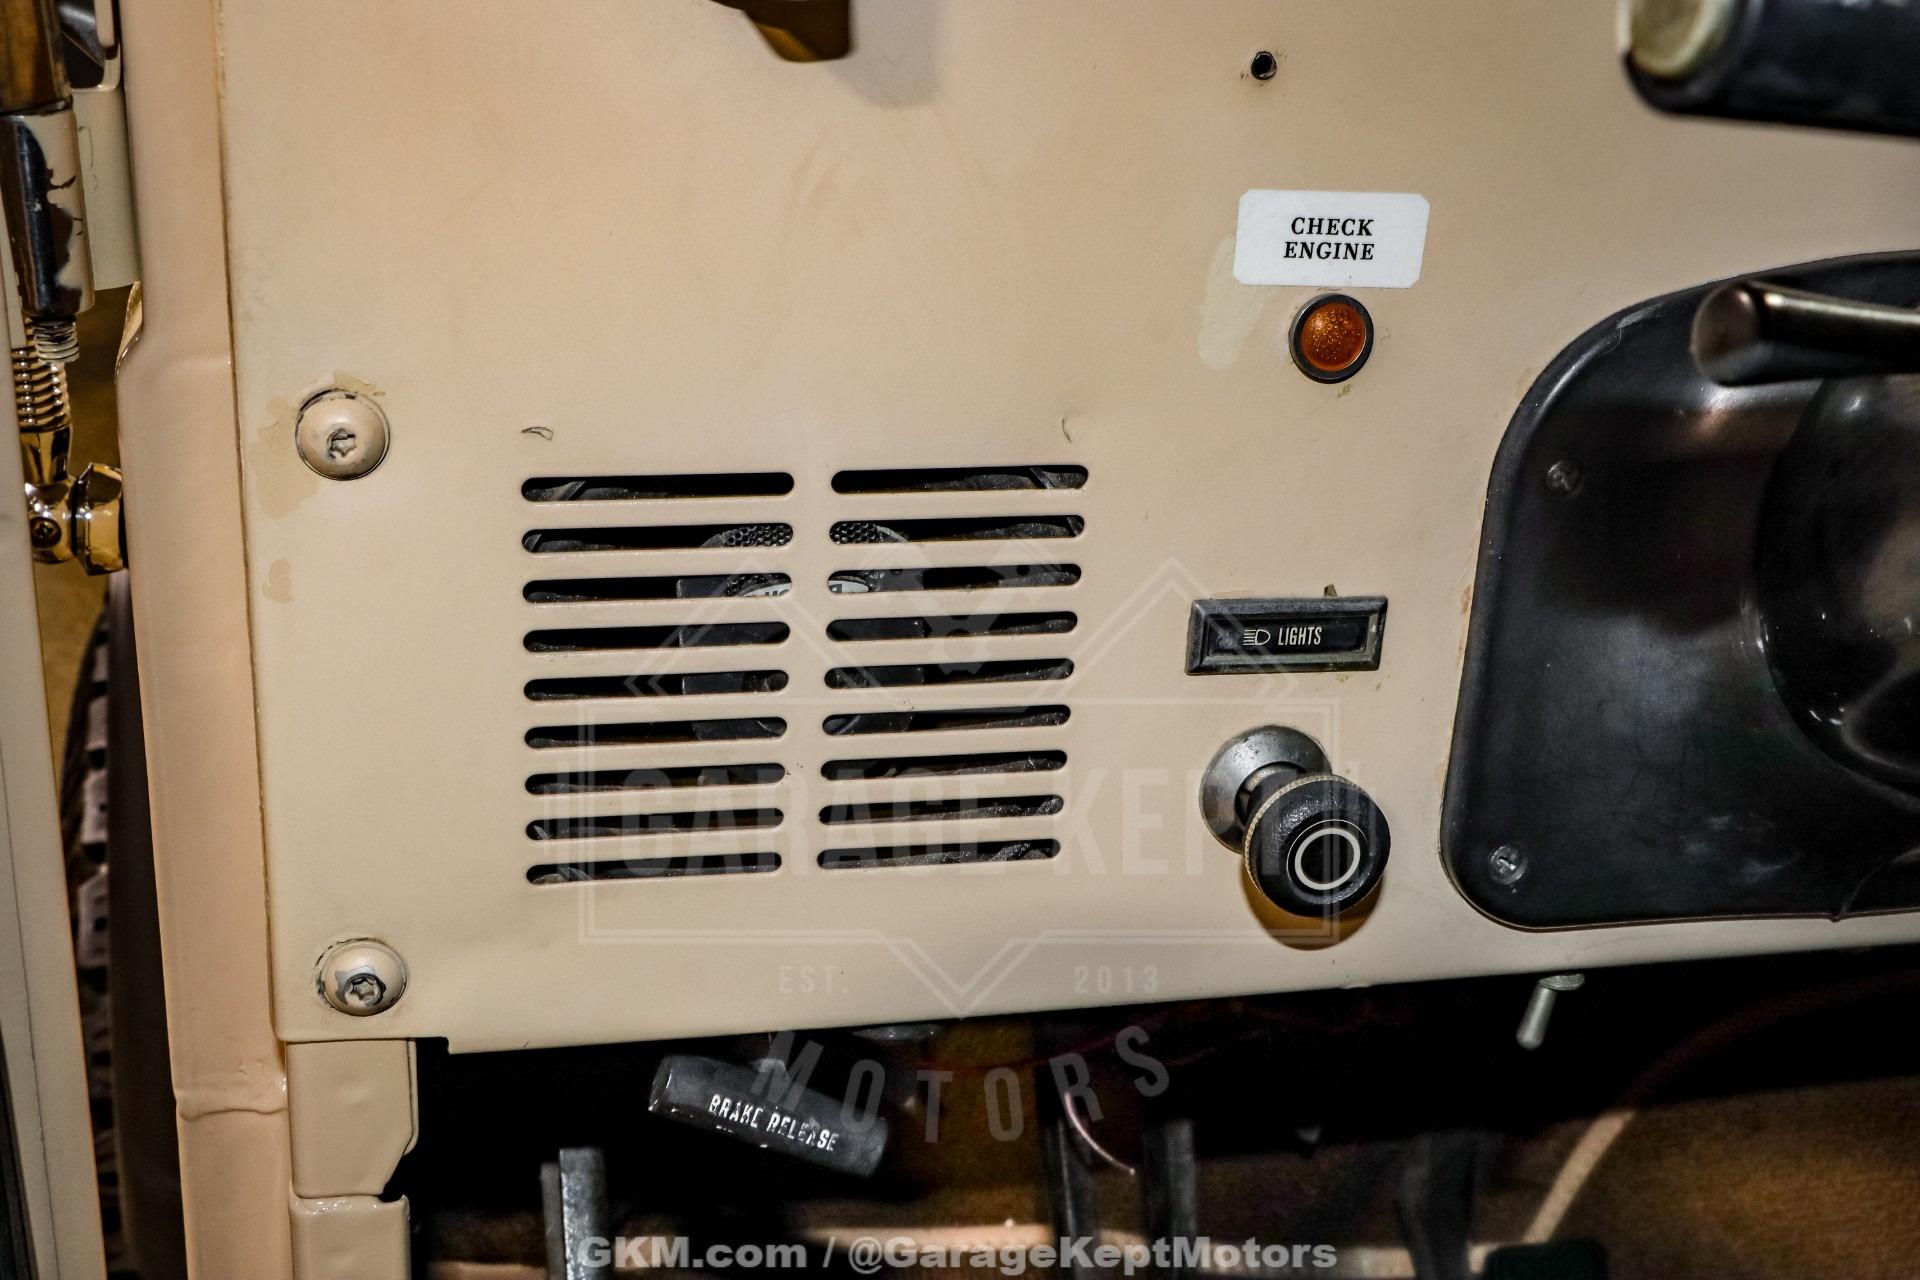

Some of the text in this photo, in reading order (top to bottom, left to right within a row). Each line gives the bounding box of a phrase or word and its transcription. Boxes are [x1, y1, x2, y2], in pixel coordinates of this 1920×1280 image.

[1291, 217, 1374, 236] CHECK
[1283, 241, 1375, 260] ENGINE
[1277, 626, 1322, 646] LIGHTS
